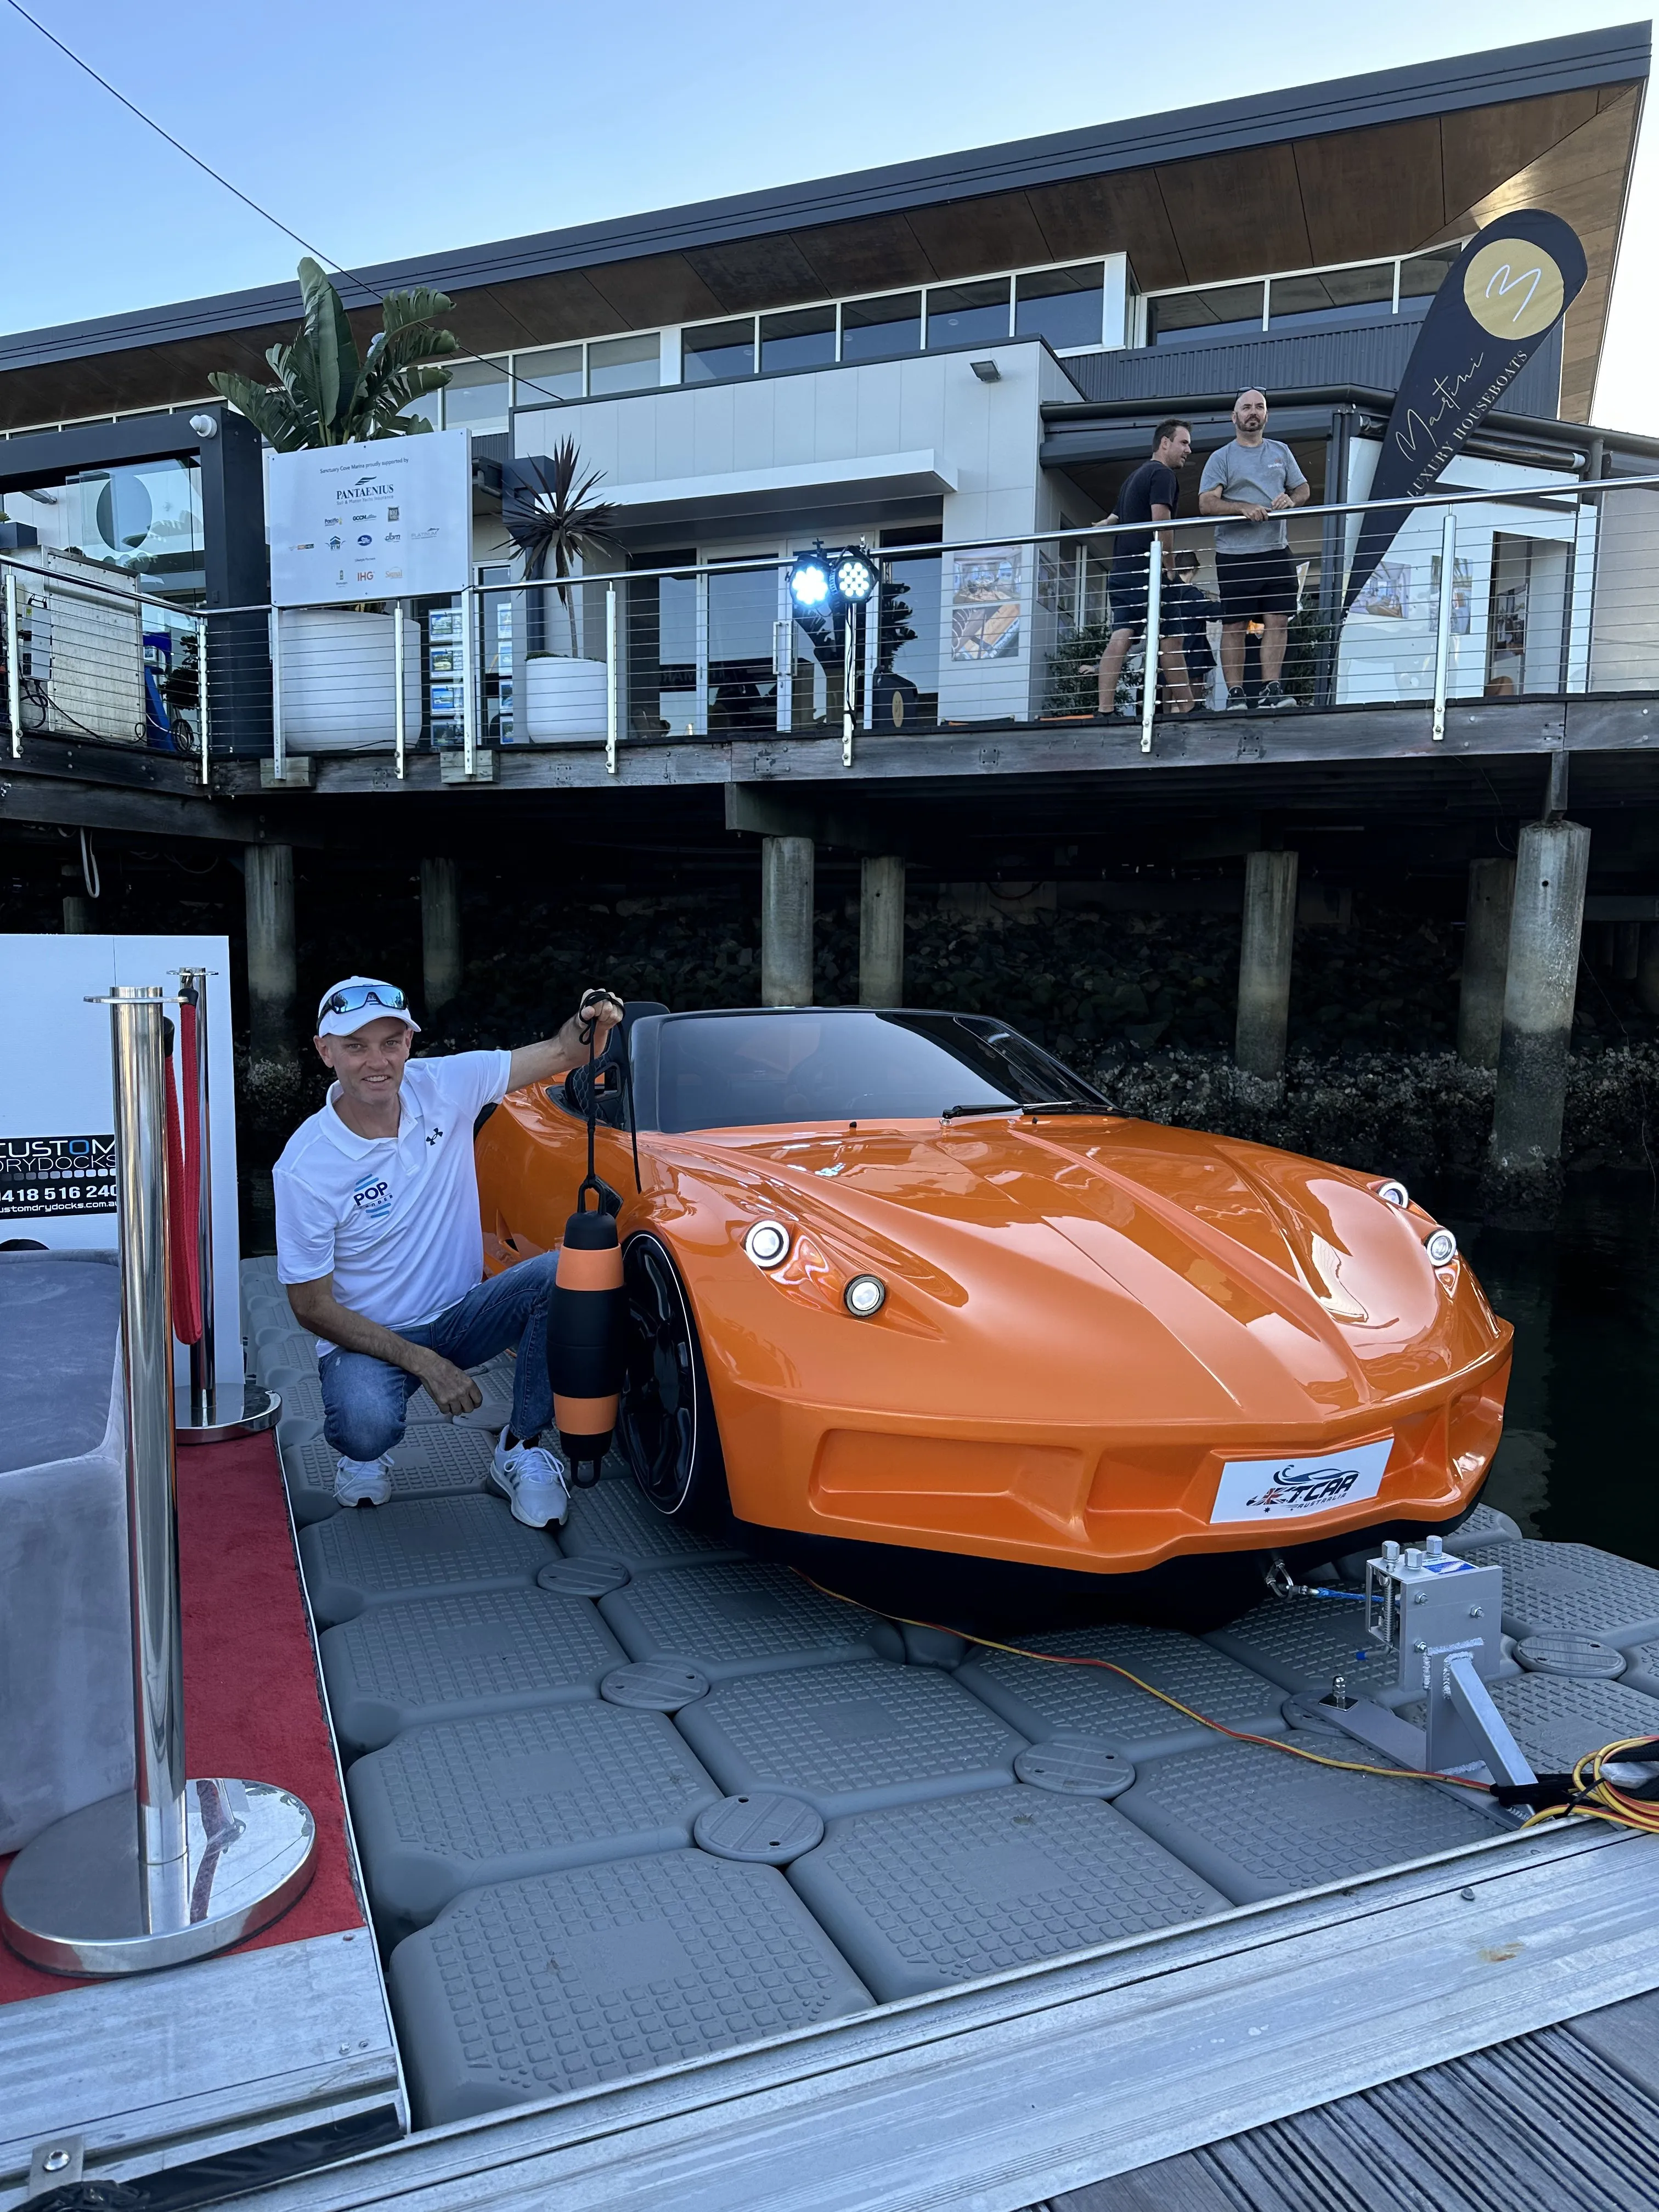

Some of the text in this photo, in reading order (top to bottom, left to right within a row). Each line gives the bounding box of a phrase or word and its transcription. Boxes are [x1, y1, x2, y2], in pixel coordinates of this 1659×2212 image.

[1395, 352, 1484, 462] Martini
[1407, 349, 1528, 498] LUXURY HOUSEBOATS
[365, 461, 381, 469] proudly
[381, 458, 403, 466] supported
[336, 484, 394, 499] PANTAENIUS
[357, 571, 374, 582] IHG
[0, 1154, 116, 1172] RYDOCKS
[0, 1188, 39, 1202] 418
[44, 1186, 81, 1200] 516
[353, 1182, 388, 1206] POP
[1297, 1492, 1347, 1509] AUSTRALIA
